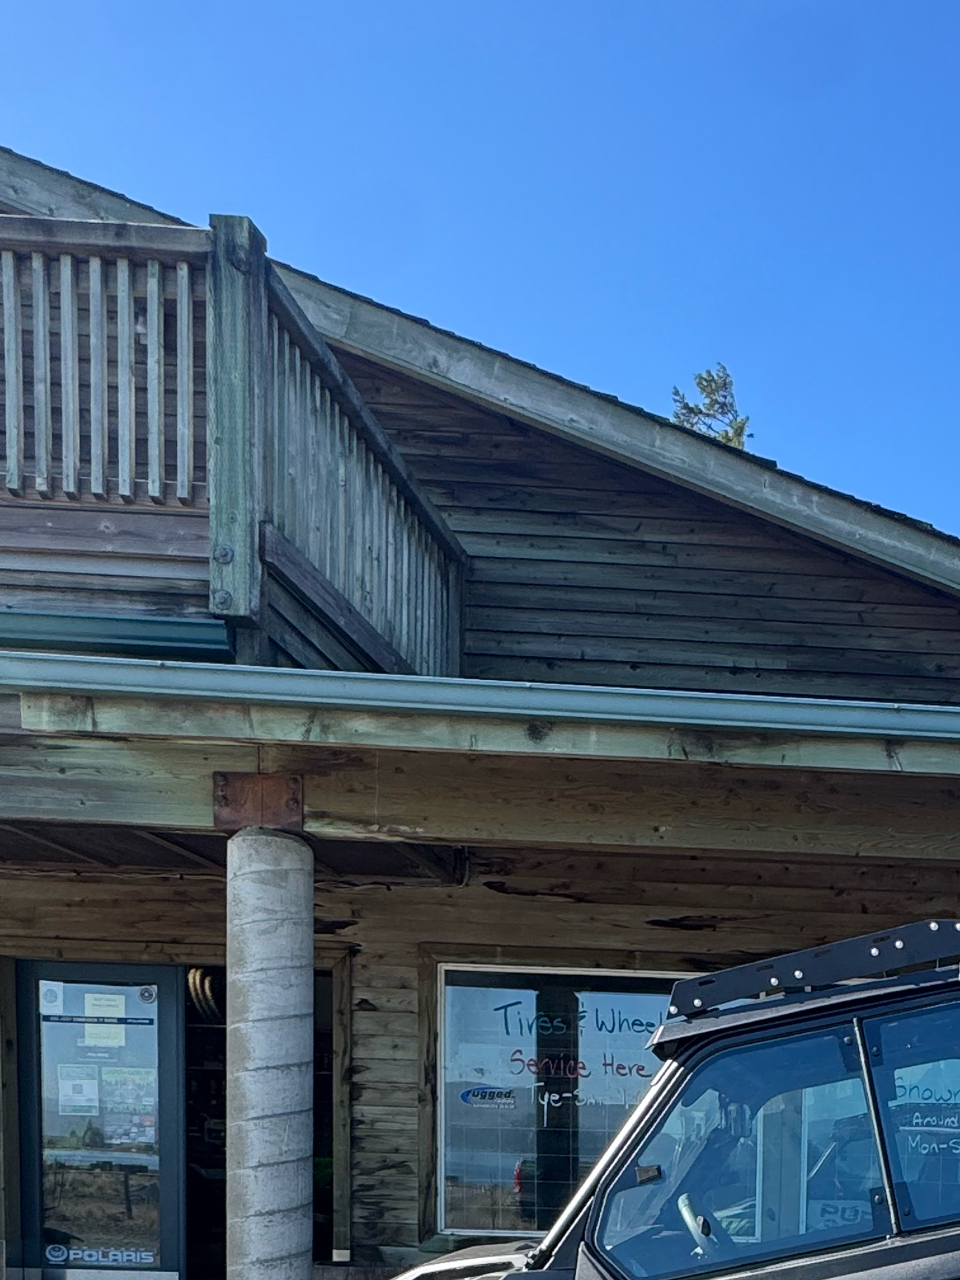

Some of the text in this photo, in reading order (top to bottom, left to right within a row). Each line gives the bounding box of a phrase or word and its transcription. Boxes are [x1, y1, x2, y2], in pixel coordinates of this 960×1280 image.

[494, 1001, 568, 1036] Tires
[509, 1049, 653, 1078] Service Here
[912, 1112, 959, 1127] Around
[68, 1249, 155, 1263] POLARIS
